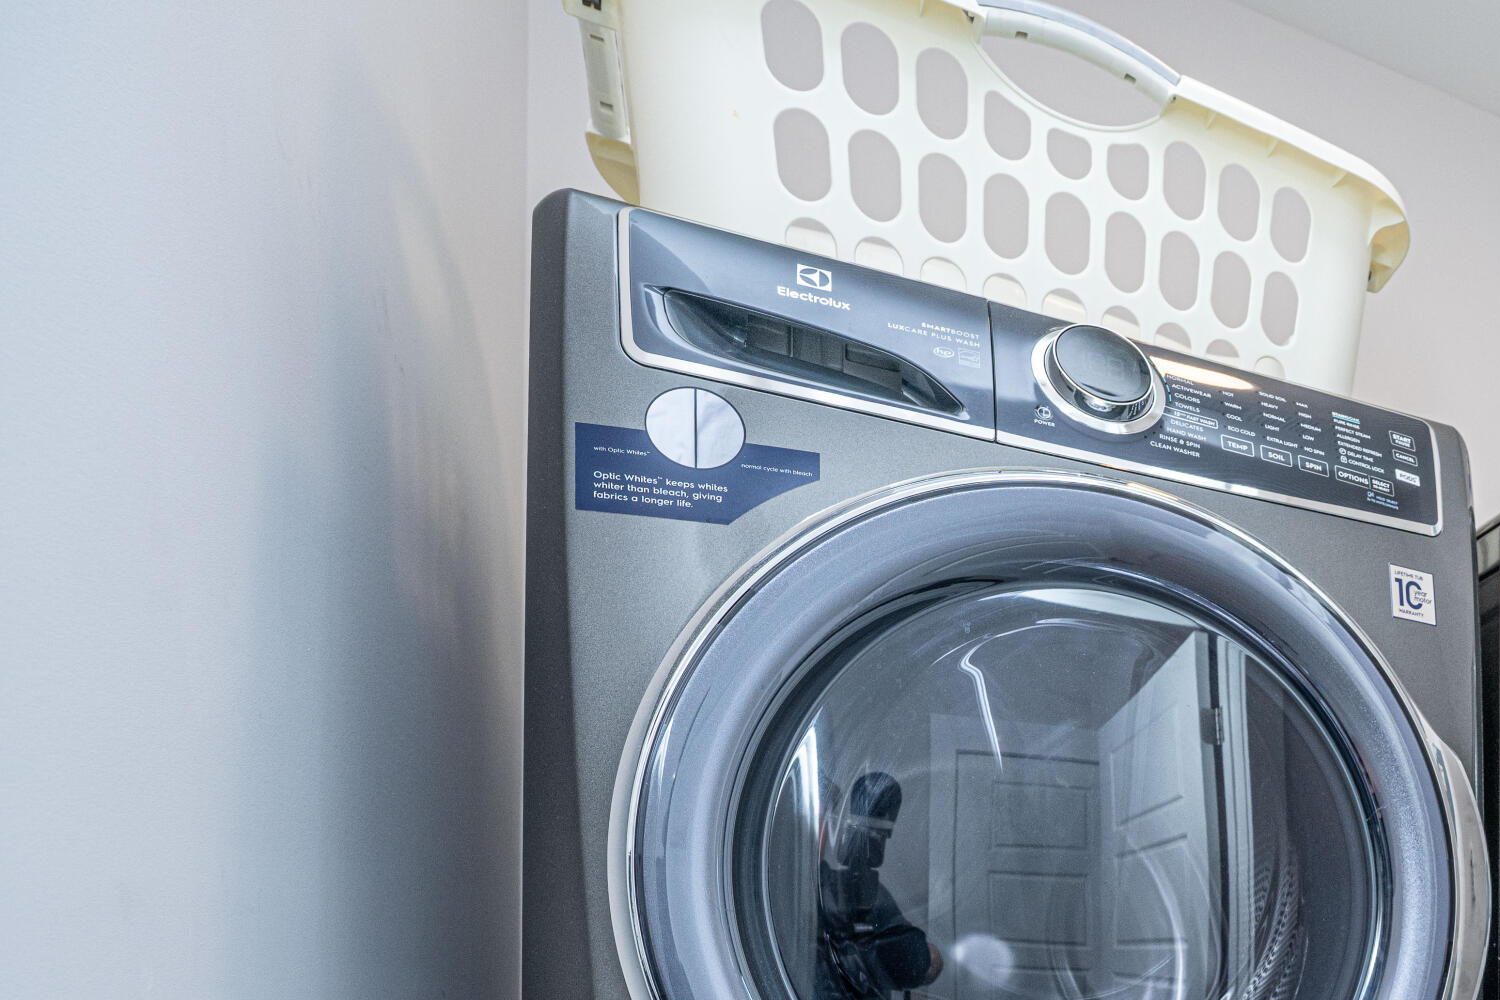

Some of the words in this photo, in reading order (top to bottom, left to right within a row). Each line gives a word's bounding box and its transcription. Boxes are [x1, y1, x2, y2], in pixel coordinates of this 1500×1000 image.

[776, 285, 851, 311] Electrolux
[887, 322, 930, 338] LUXCARE
[931, 331, 952, 342] PLUS
[955, 337, 980, 348] WASH
[921, 322, 980, 340] SMARTBOOST
[1172, 384, 1212, 399] ACTIVEWEAR
[1174, 392, 1200, 404] COLORS
[1175, 401, 1200, 413] TOWELS
[1226, 413, 1243, 422] COOL
[1263, 412, 1286, 423] NORMAL
[1170, 419, 1203, 432] DELICATES
[1228, 425, 1239, 433] ECO
[1240, 429, 1256, 437] COLD
[1264, 424, 1280, 432] LIGHT
[1300, 423, 1321, 432] MEDIUM
[1167, 427, 1186, 436] HAND
[1187, 432, 1206, 441] WASH
[1302, 434, 1315, 442] LOW
[1335, 425, 1354, 435] PERFECT
[1355, 431, 1371, 439] STEAM
[1160, 433, 1179, 444] RINSE
[1186, 440, 1200, 449] SPIN
[1266, 436, 1283, 445] EXTRA
[1283, 440, 1298, 448] LIGHT
[1337, 433, 1360, 444] ALLERGEN
[1392, 434, 1411, 443] START
[607, 447, 625, 455] Optic
[1150, 441, 1172, 451] CLEAN
[1173, 446, 1200, 458] WASHER
[1227, 440, 1248, 451] TEMP
[1338, 441, 1362, 452] EXTENDED
[1268, 451, 1285, 462] SOIL
[1313, 448, 1325, 456] SPIN
[1347, 451, 1361, 459] DELAY
[1395, 453, 1415, 463] CANCEL
[741, 463, 762, 471] normal
[763, 466, 778, 474] cycle
[792, 470, 813, 478] bleach
[1305, 461, 1322, 471] SPIN
[1348, 459, 1371, 470] CONTROL
[1371, 466, 1385, 474] LOCK
[593, 470, 621, 482] Optic
[665, 478, 695, 490] keeps
[697, 483, 728, 492] whites
[1338, 471, 1369, 485] OPTIONS
[1372, 479, 1390, 488] SELECT
[593, 481, 624, 491] whiter
[627, 484, 650, 494] than
[653, 486, 689, 499] bleach,
[692, 492, 723, 503] giving
[593, 490, 628, 501] fabrics
[641, 495, 674, 507] longer
[677, 499, 693, 508] life.
[1399, 608, 1424, 617] WARRANTY
